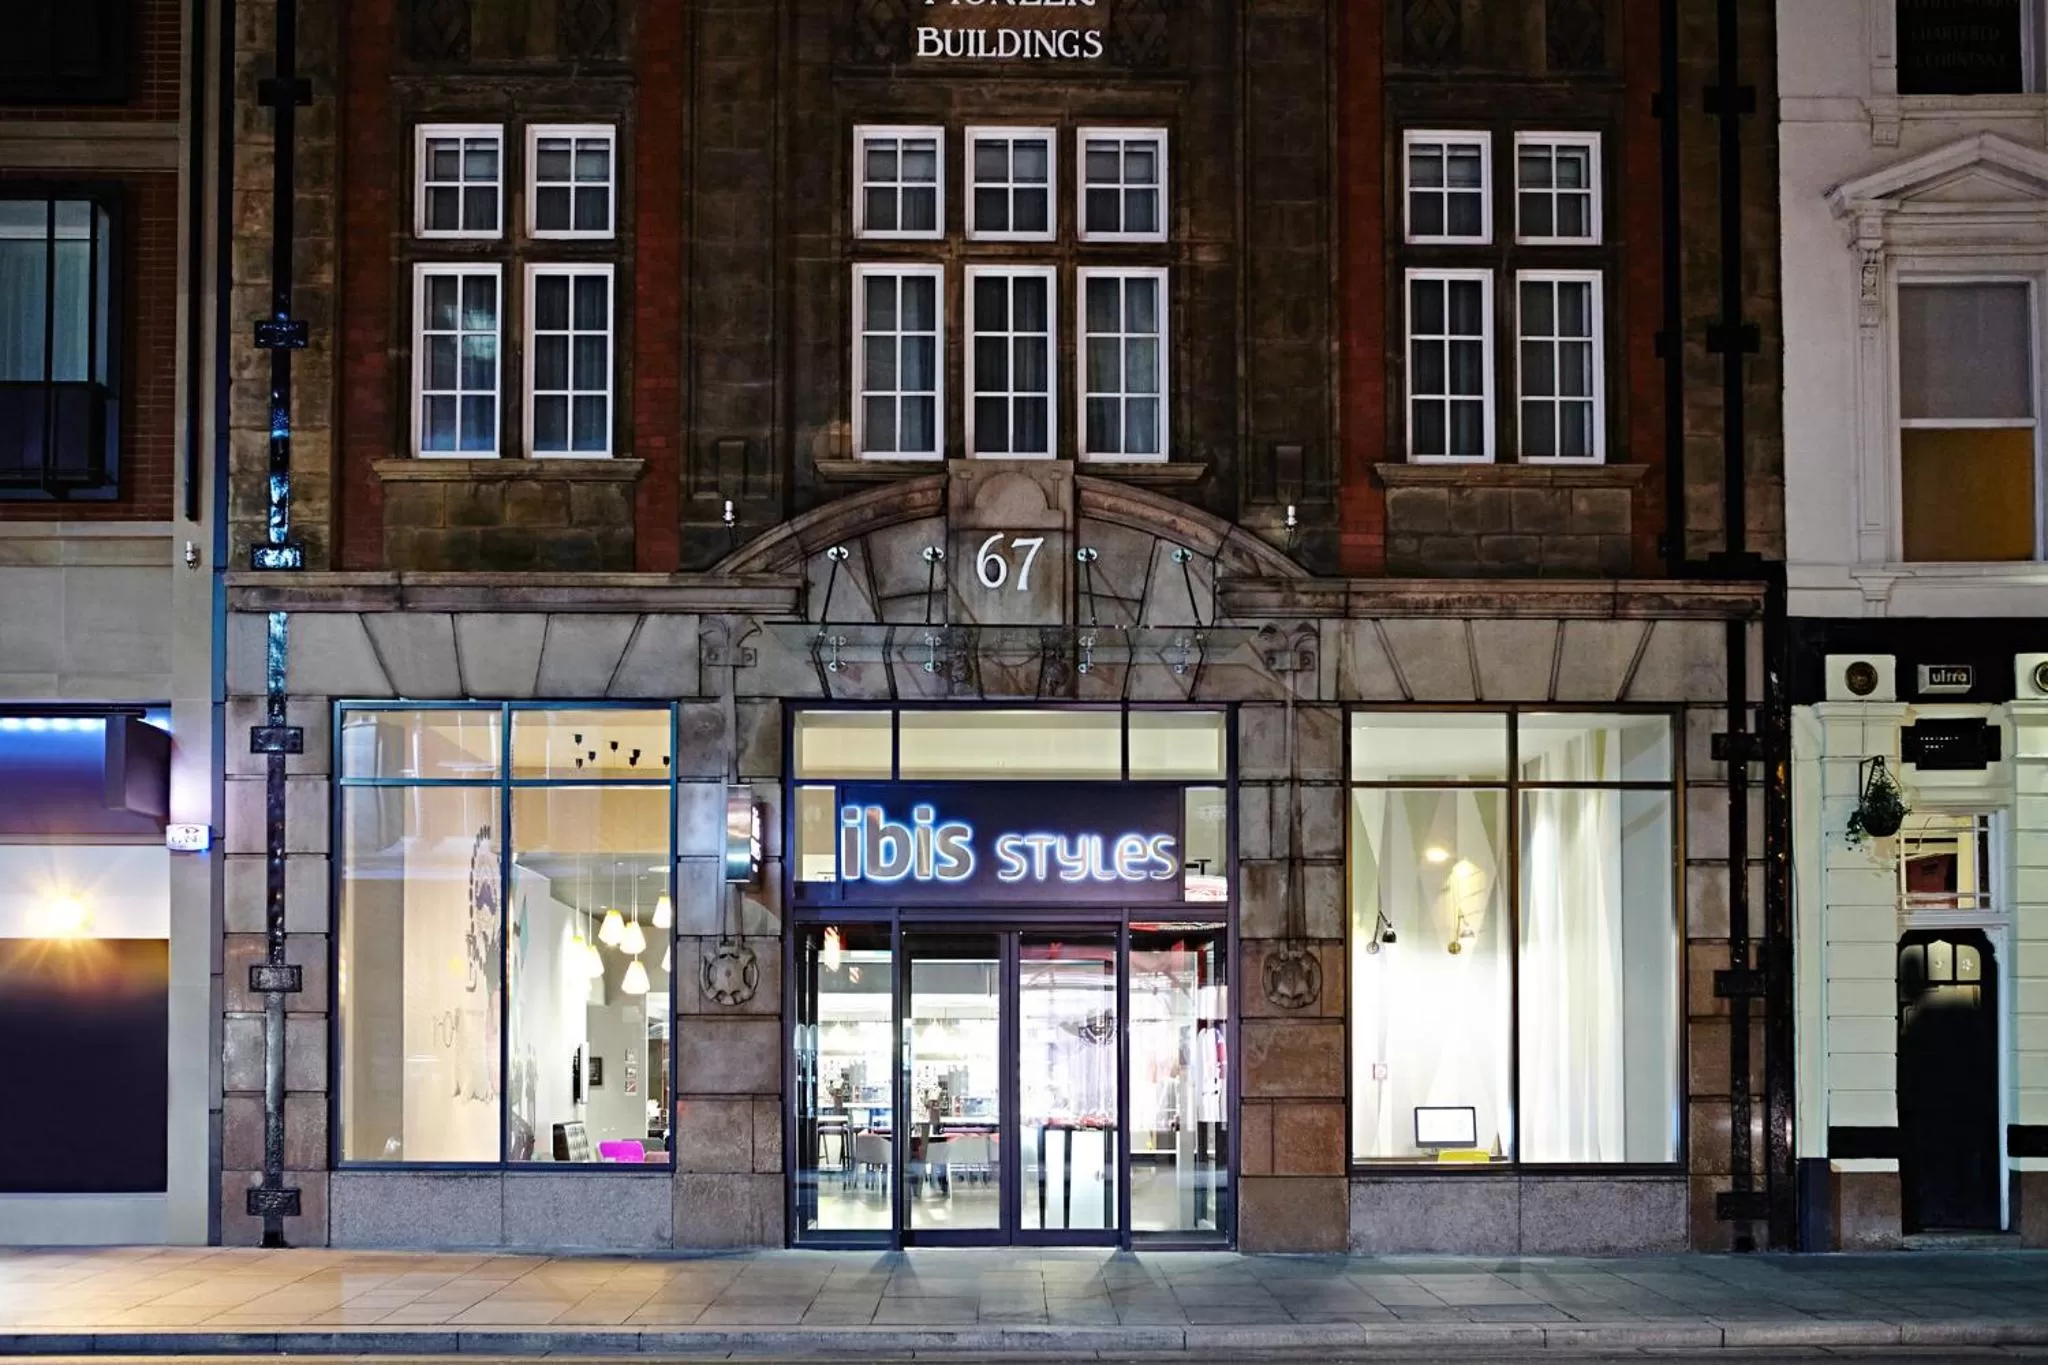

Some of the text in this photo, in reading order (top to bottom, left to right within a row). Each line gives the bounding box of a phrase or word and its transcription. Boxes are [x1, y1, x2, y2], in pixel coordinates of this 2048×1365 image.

[917, 27, 1103, 58] BUILDINGS
[977, 532, 1044, 591] 67
[841, 805, 975, 881] ibis
